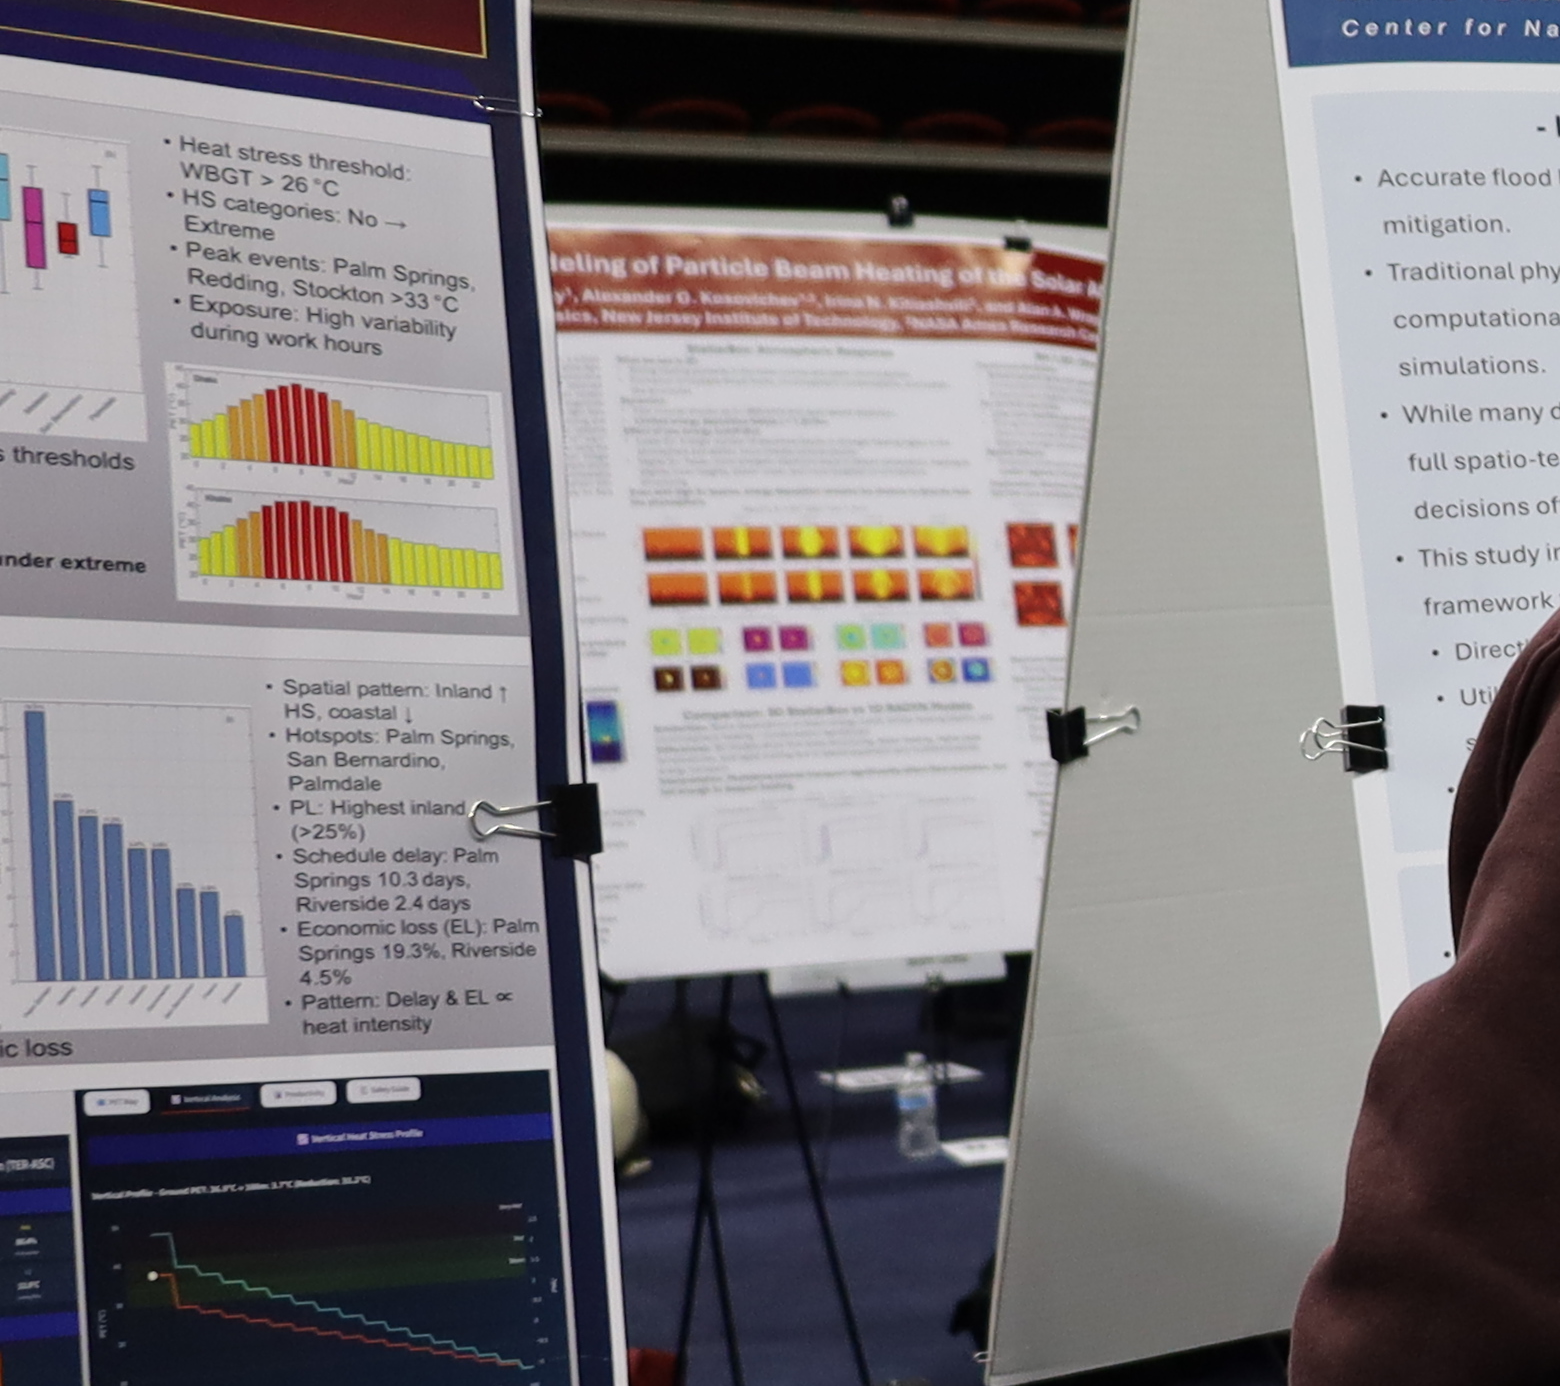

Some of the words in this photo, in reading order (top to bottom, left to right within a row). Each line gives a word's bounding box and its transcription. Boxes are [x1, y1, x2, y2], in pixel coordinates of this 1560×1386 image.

[1342, 19, 1447, 37] Center
[1465, 18, 1506, 36] for
[180, 135, 231, 158] Heat
[237, 146, 302, 167] stress
[308, 153, 413, 182] threshold:
[180, 162, 252, 186] WBGT
[261, 175, 274, 186] >
[282, 175, 308, 193] 26
[1378, 169, 1486, 187] Accurate
[1492, 168, 1552, 187] flood
[183, 189, 216, 208] HS
[223, 197, 340, 222] categories:
[348, 208, 378, 228] No
[184, 214, 275, 241] Extreme
[1383, 215, 1510, 238] mitigation.
[633, 256, 661, 274] of
[665, 254, 770, 278] Particle
[774, 256, 849, 281] Beam
[854, 261, 954, 289] Heating
[958, 265, 984, 283] of
[988, 266, 1026, 287] the
[1031, 269, 1084, 295] Solar
[12, 446, 135, 471] thresholds
[60, 557, 146, 573] extreme
[286, 728, 378, 746] Hotspots:
[386, 728, 434, 744] Palm
[441, 729, 514, 750] Springs,
[287, 751, 327, 767] San
[334, 751, 445, 770] Bernardino,
[288, 775, 382, 791] Palmdale
